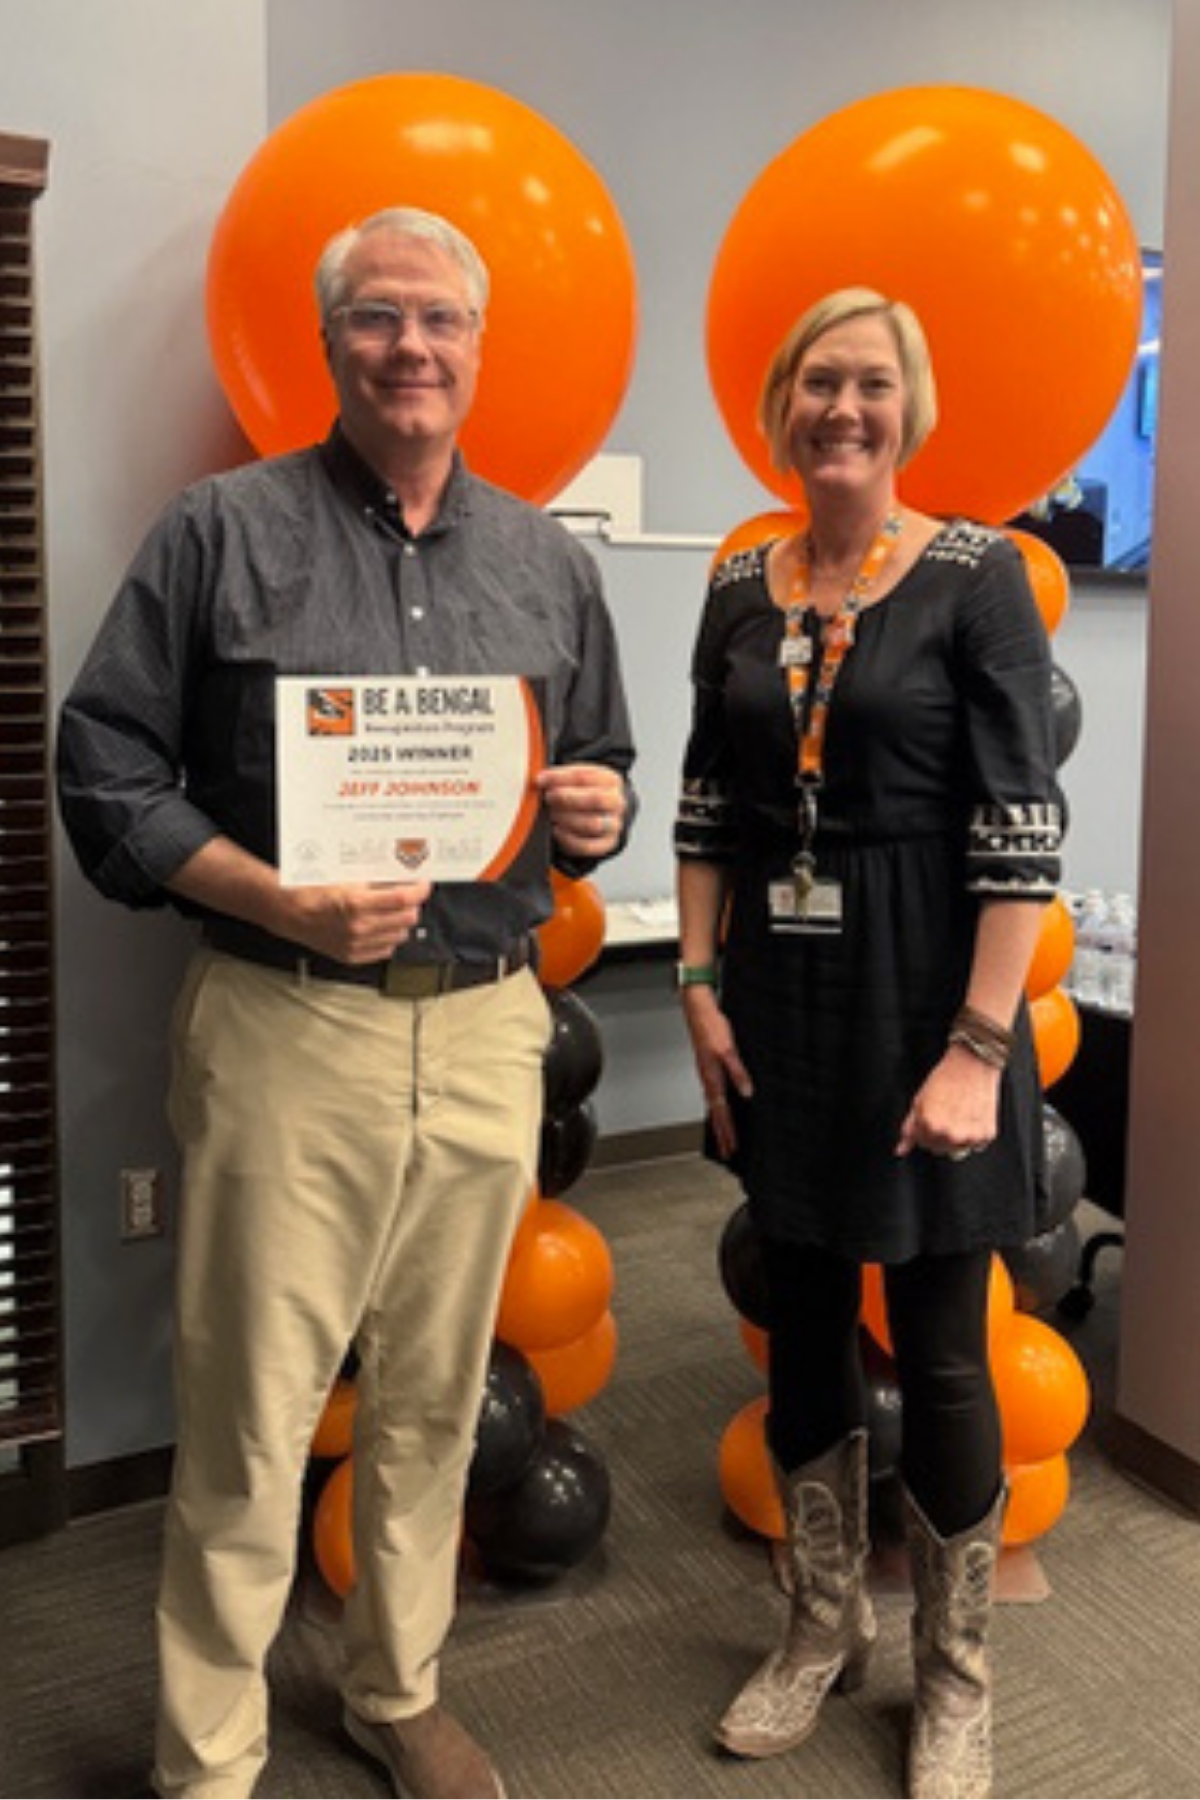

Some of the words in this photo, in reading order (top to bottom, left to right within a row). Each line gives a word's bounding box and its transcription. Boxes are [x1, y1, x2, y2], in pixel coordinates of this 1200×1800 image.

[363, 687, 388, 715] BE
[395, 688, 412, 715] A
[417, 687, 494, 715] BENGAL
[443, 722, 494, 736] Program
[347, 745, 392, 762] 2025
[396, 744, 472, 761] WINNER
[337, 781, 379, 797] JEFF
[383, 781, 481, 797] JOHNSON
